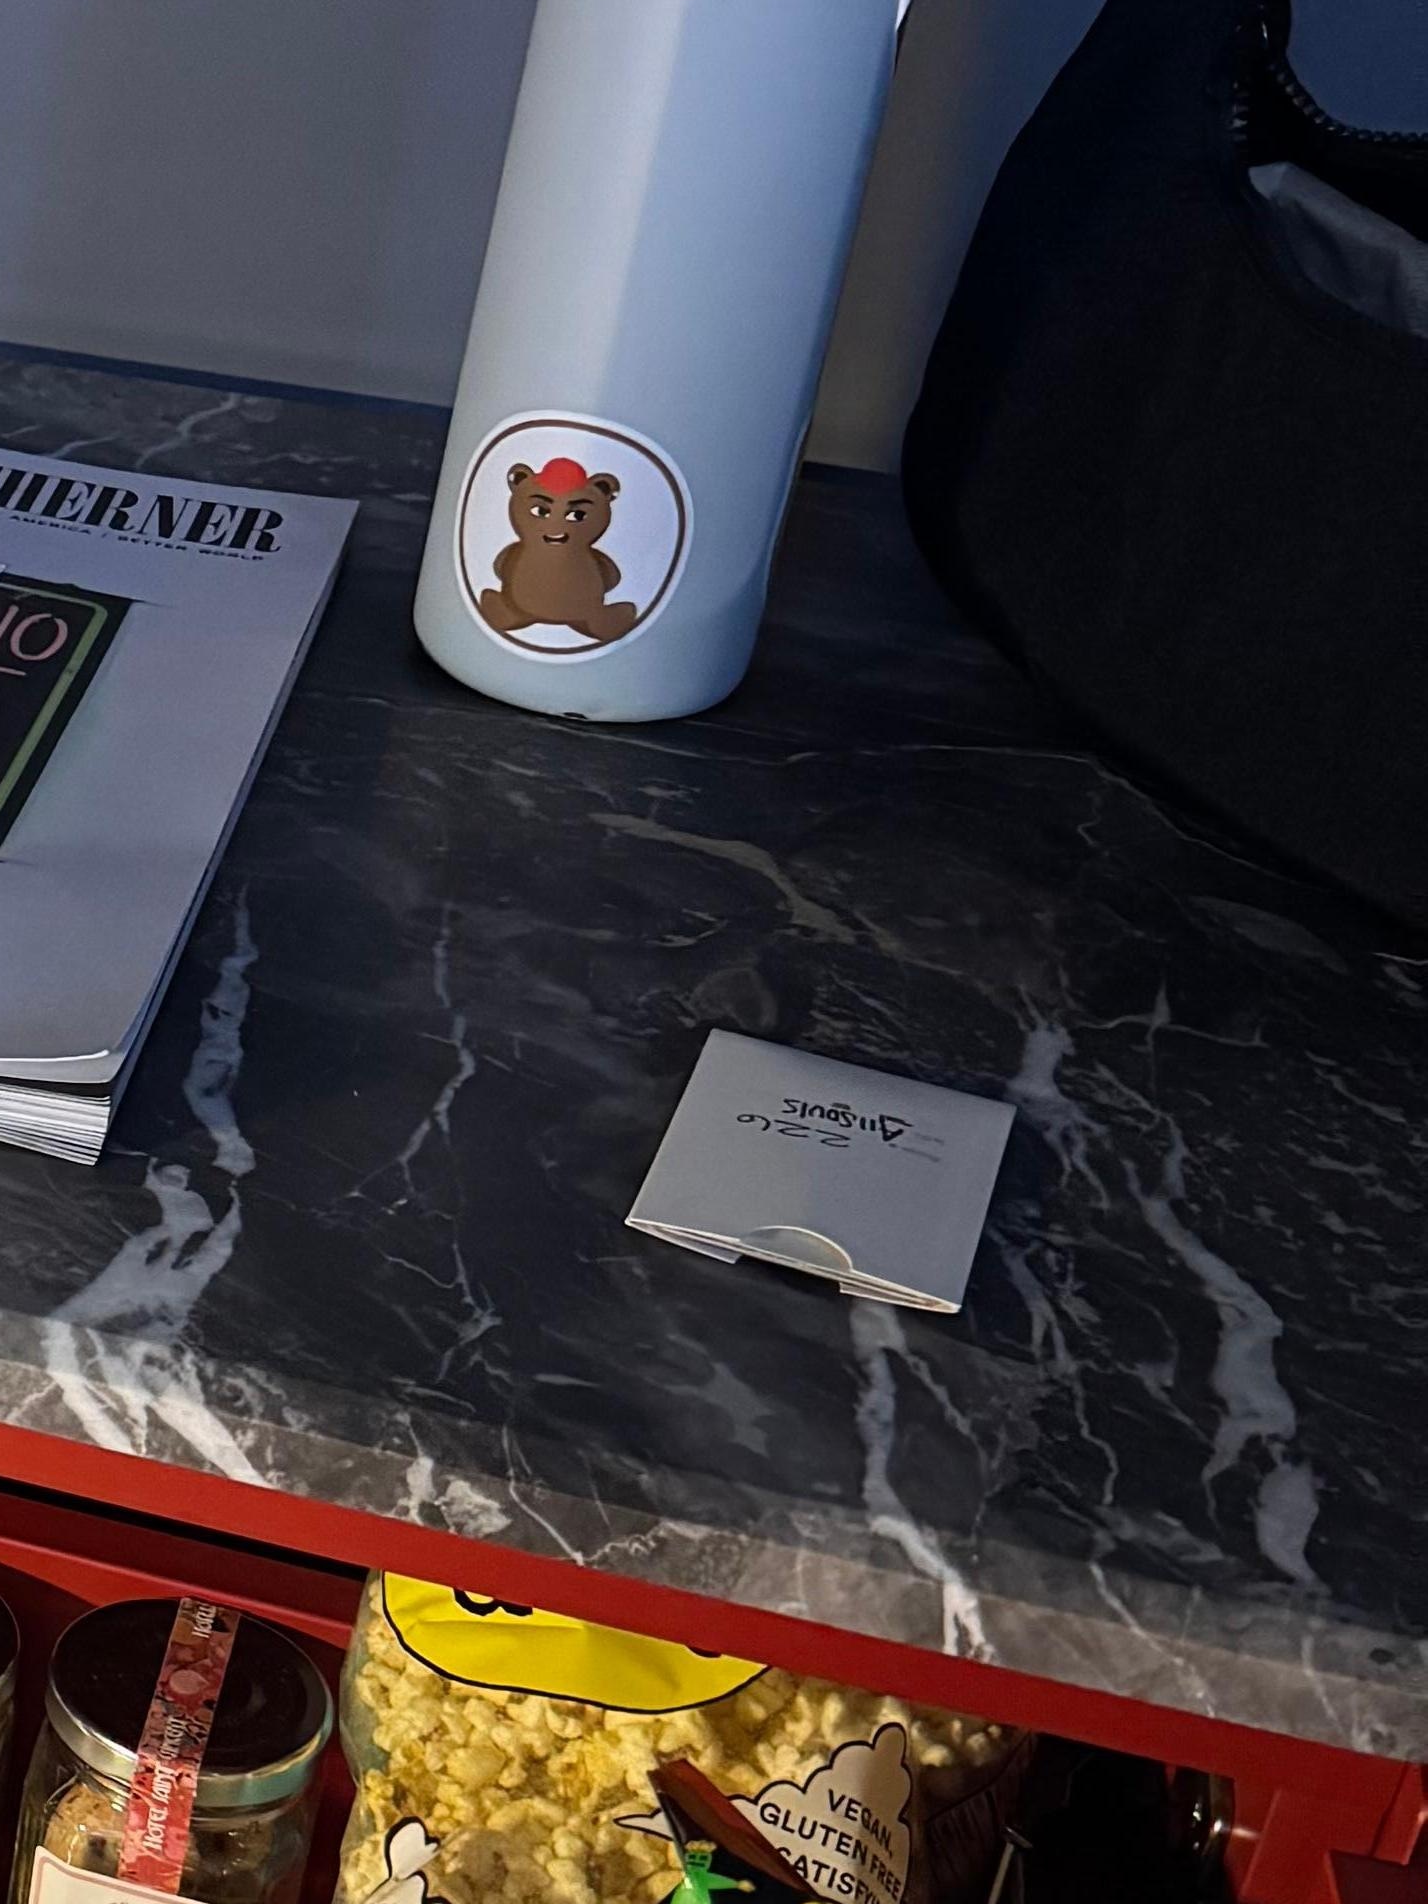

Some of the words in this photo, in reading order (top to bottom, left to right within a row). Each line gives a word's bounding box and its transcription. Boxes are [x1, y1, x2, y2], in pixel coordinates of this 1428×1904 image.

[7, 513, 92, 536] AMERICA
[116, 534, 189, 552] BETTER
[197, 546, 265, 563] WORLD
[736, 1112, 852, 1150] 226
[759, 1802, 869, 1866] GLUTEN
[869, 1857, 903, 1902] FREE
[826, 1788, 895, 1858] VEGAN,
